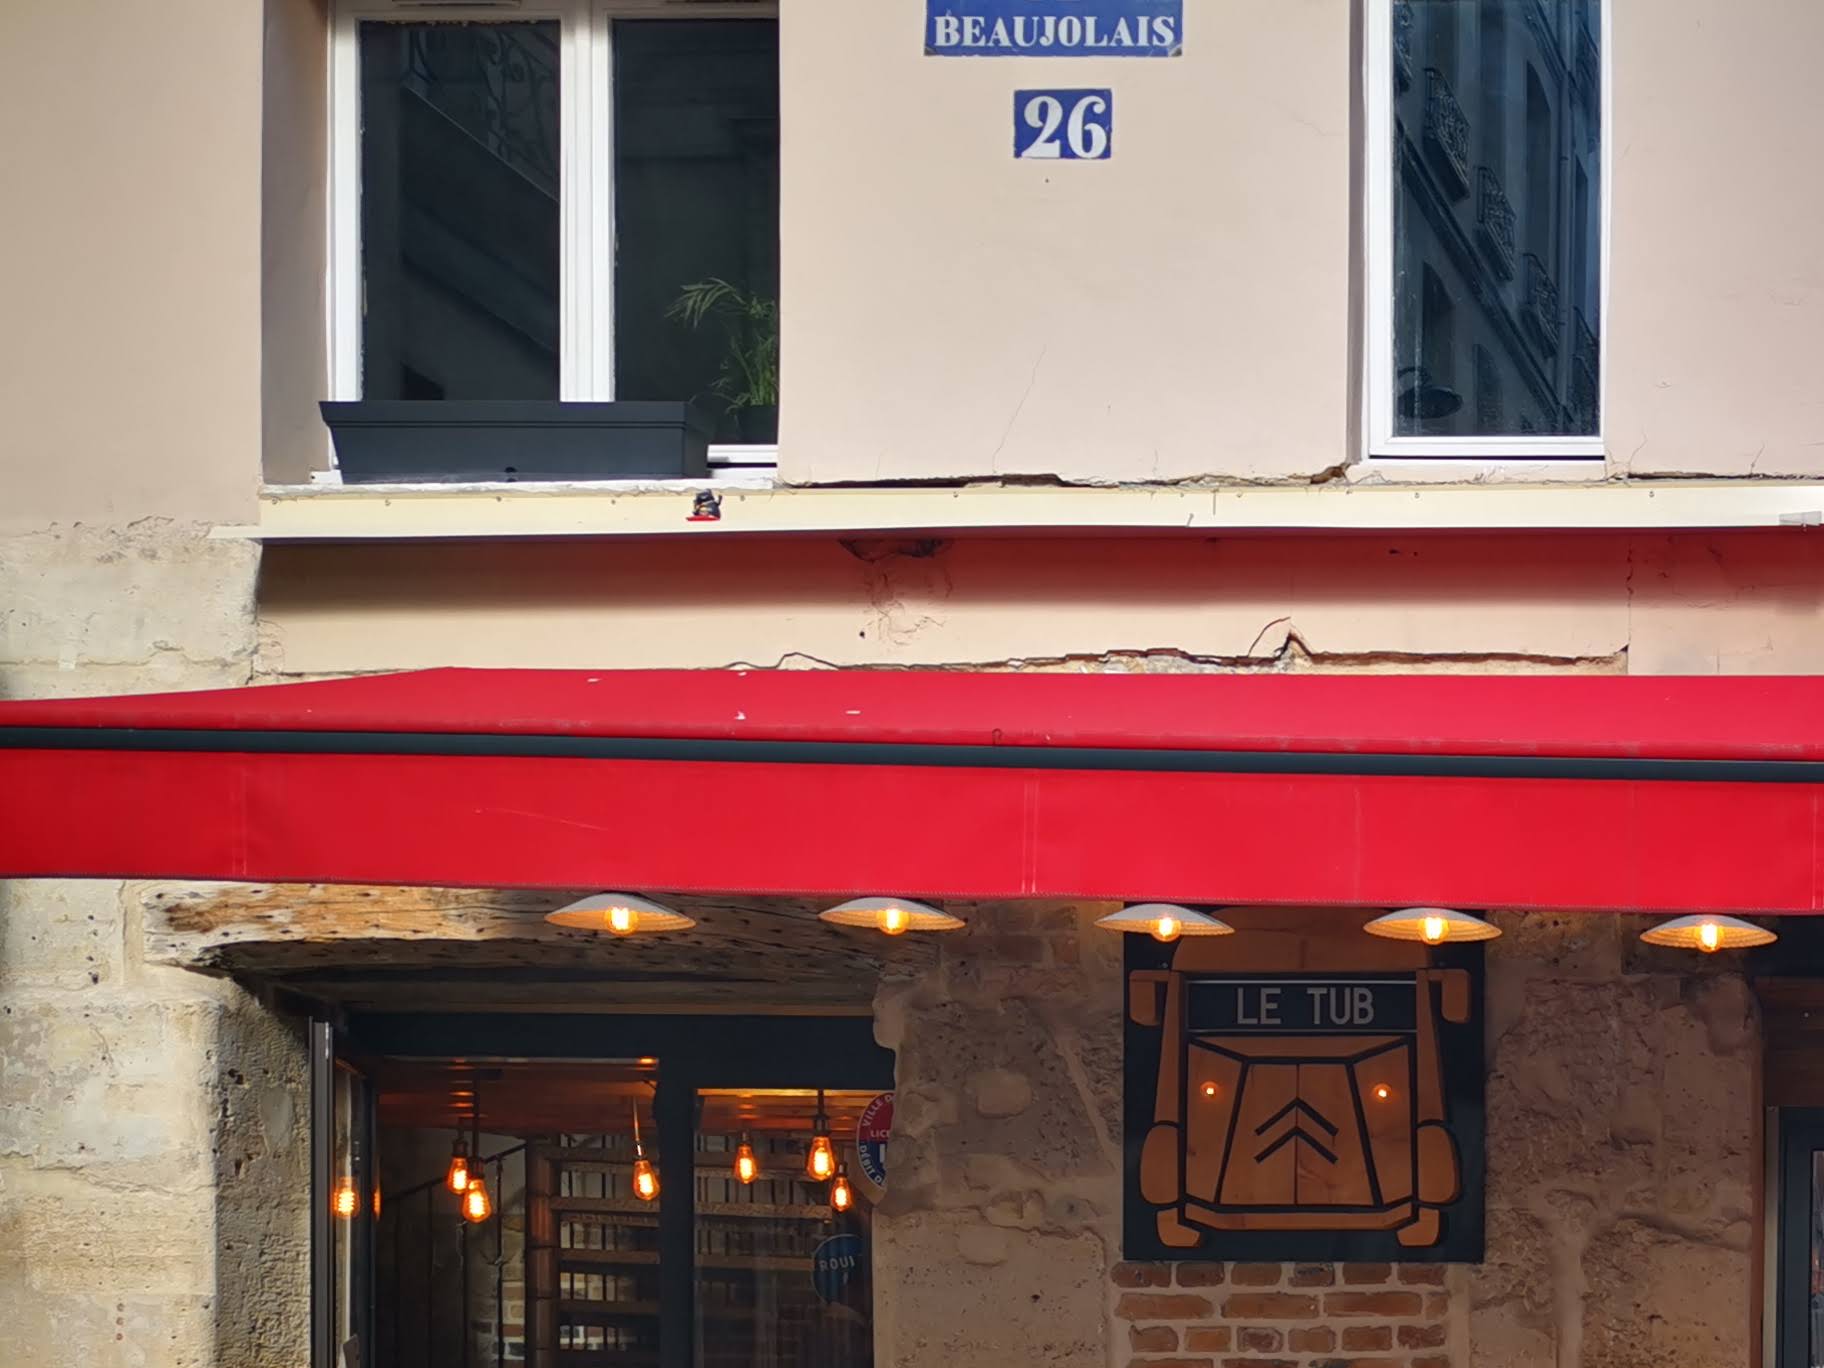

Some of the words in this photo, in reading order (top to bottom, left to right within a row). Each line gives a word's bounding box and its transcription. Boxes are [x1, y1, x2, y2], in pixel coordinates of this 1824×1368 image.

[933, 16, 1175, 47] BEAUJOLAIS
[1021, 95, 1107, 159] 26
[1237, 988, 1281, 1025] LE
[1307, 987, 1374, 1025] TUB
